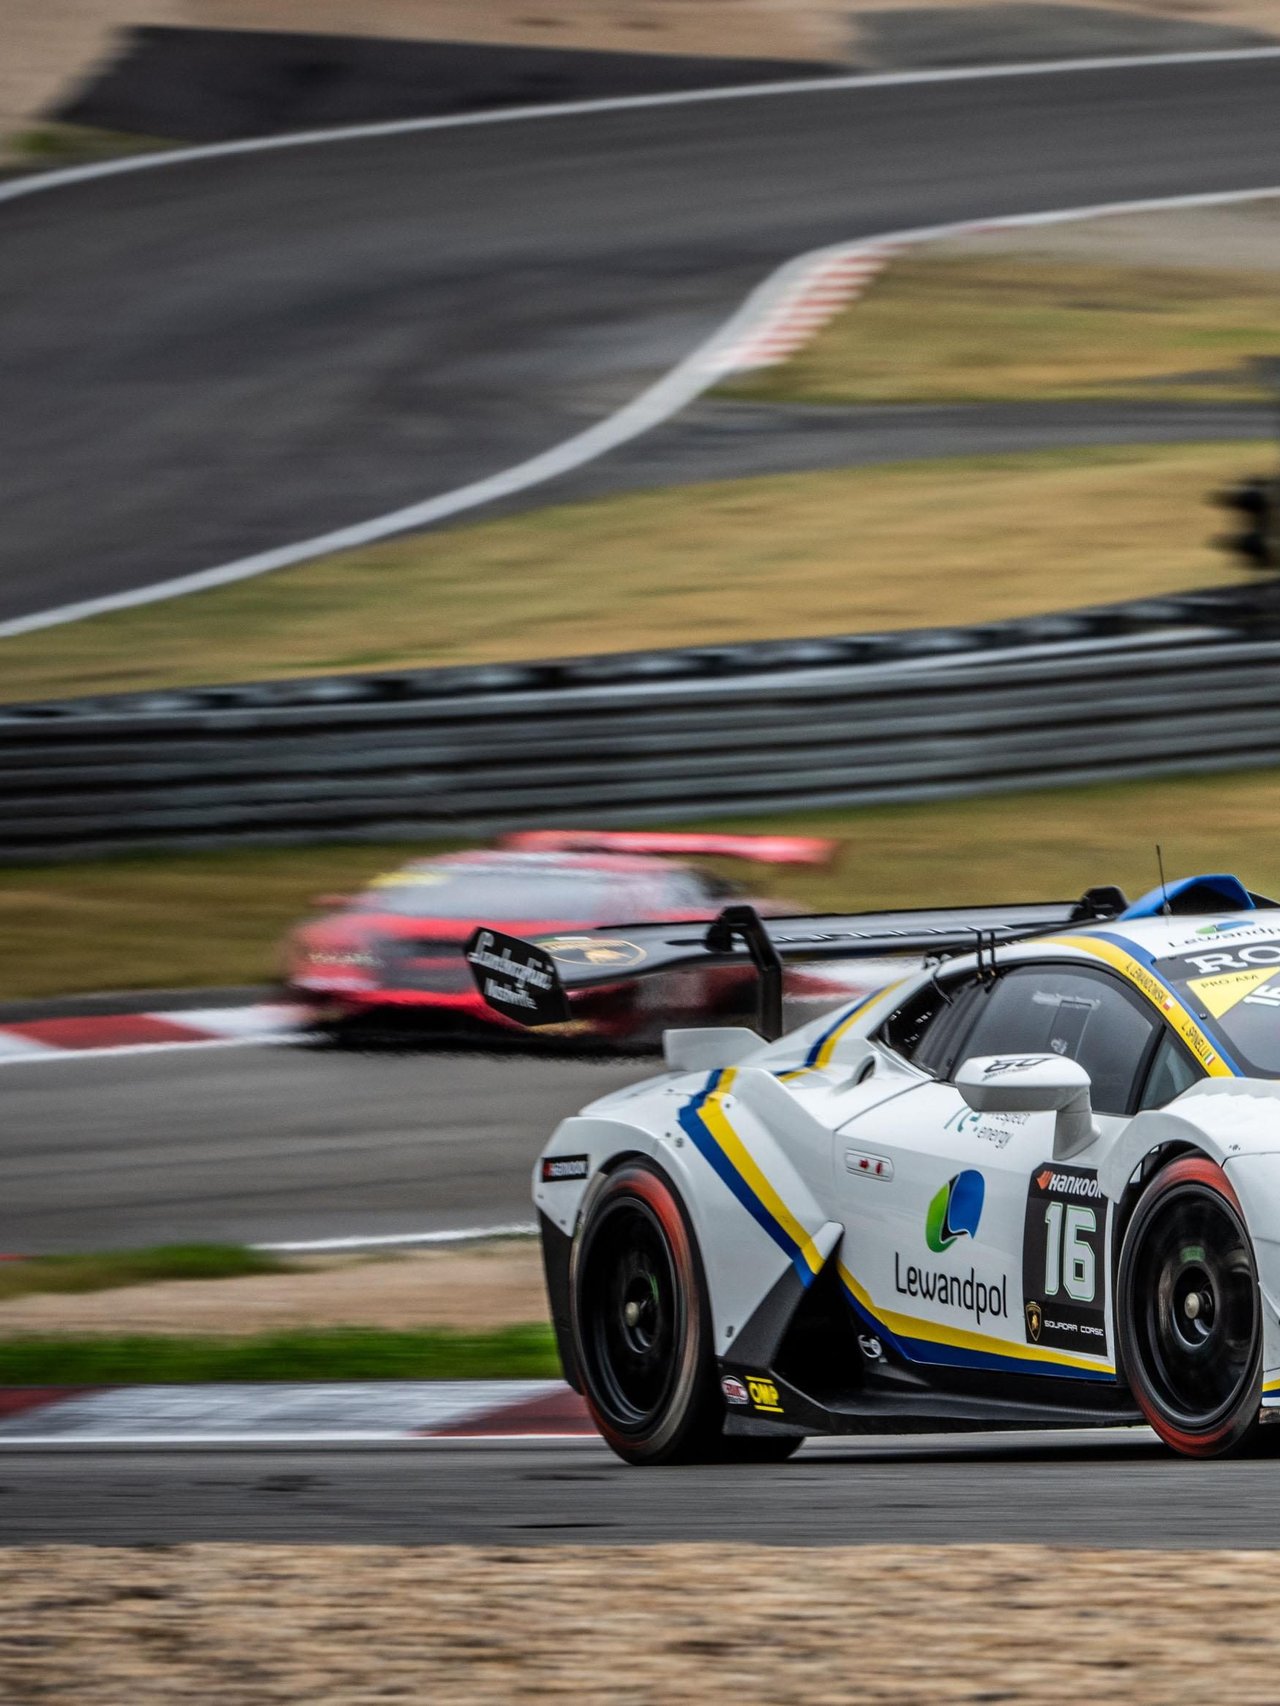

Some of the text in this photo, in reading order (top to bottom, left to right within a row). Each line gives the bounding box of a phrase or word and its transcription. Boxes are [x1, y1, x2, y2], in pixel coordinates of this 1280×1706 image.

[1044, 1201, 1098, 1303] 16
[895, 1251, 1009, 1326] Lewandpol
[1044, 1319, 1105, 1337] SQUADRA CORSE
[747, 1381, 779, 1407] OMP
